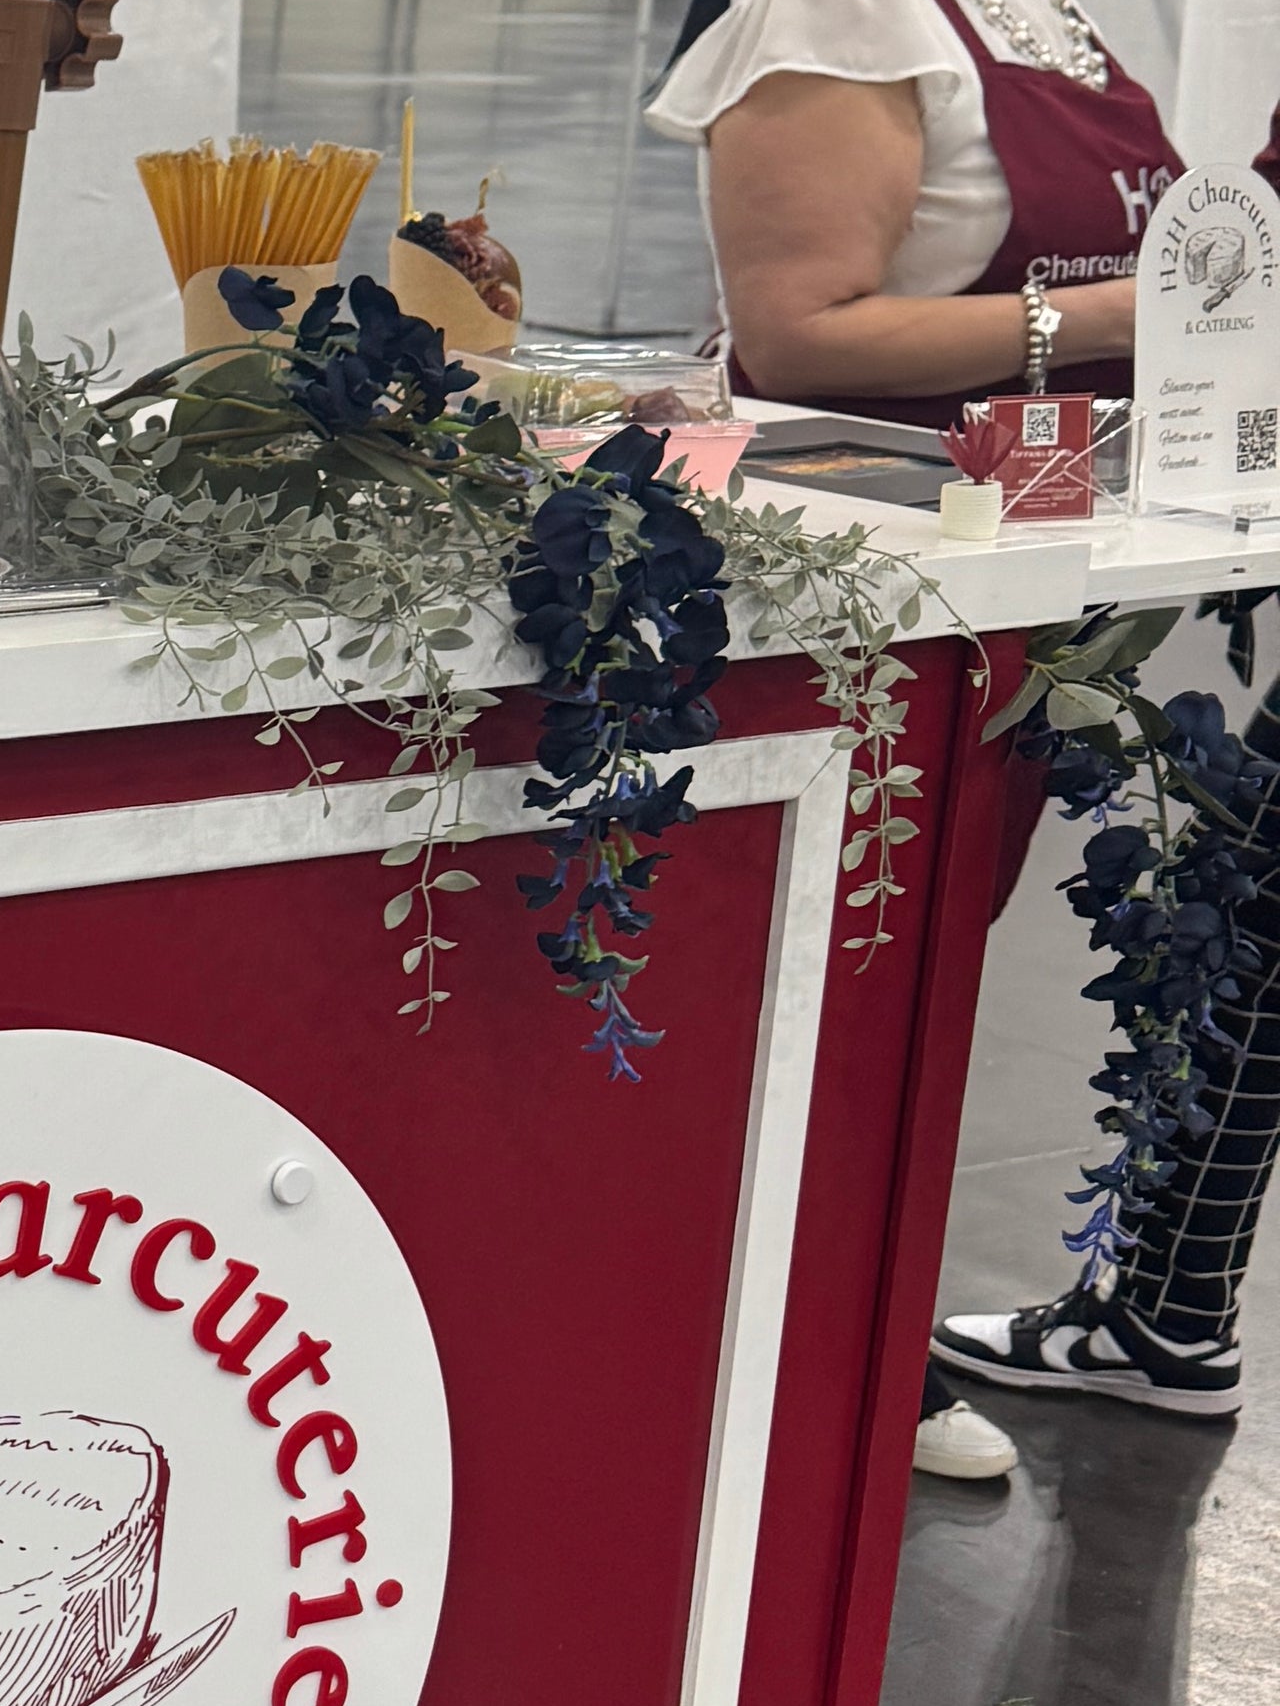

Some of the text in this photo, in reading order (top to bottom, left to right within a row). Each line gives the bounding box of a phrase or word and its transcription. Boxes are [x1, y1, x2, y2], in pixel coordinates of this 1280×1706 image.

[1160, 178, 1279, 293] H2H Charcuterie
[1195, 316, 1255, 334] CATERING
